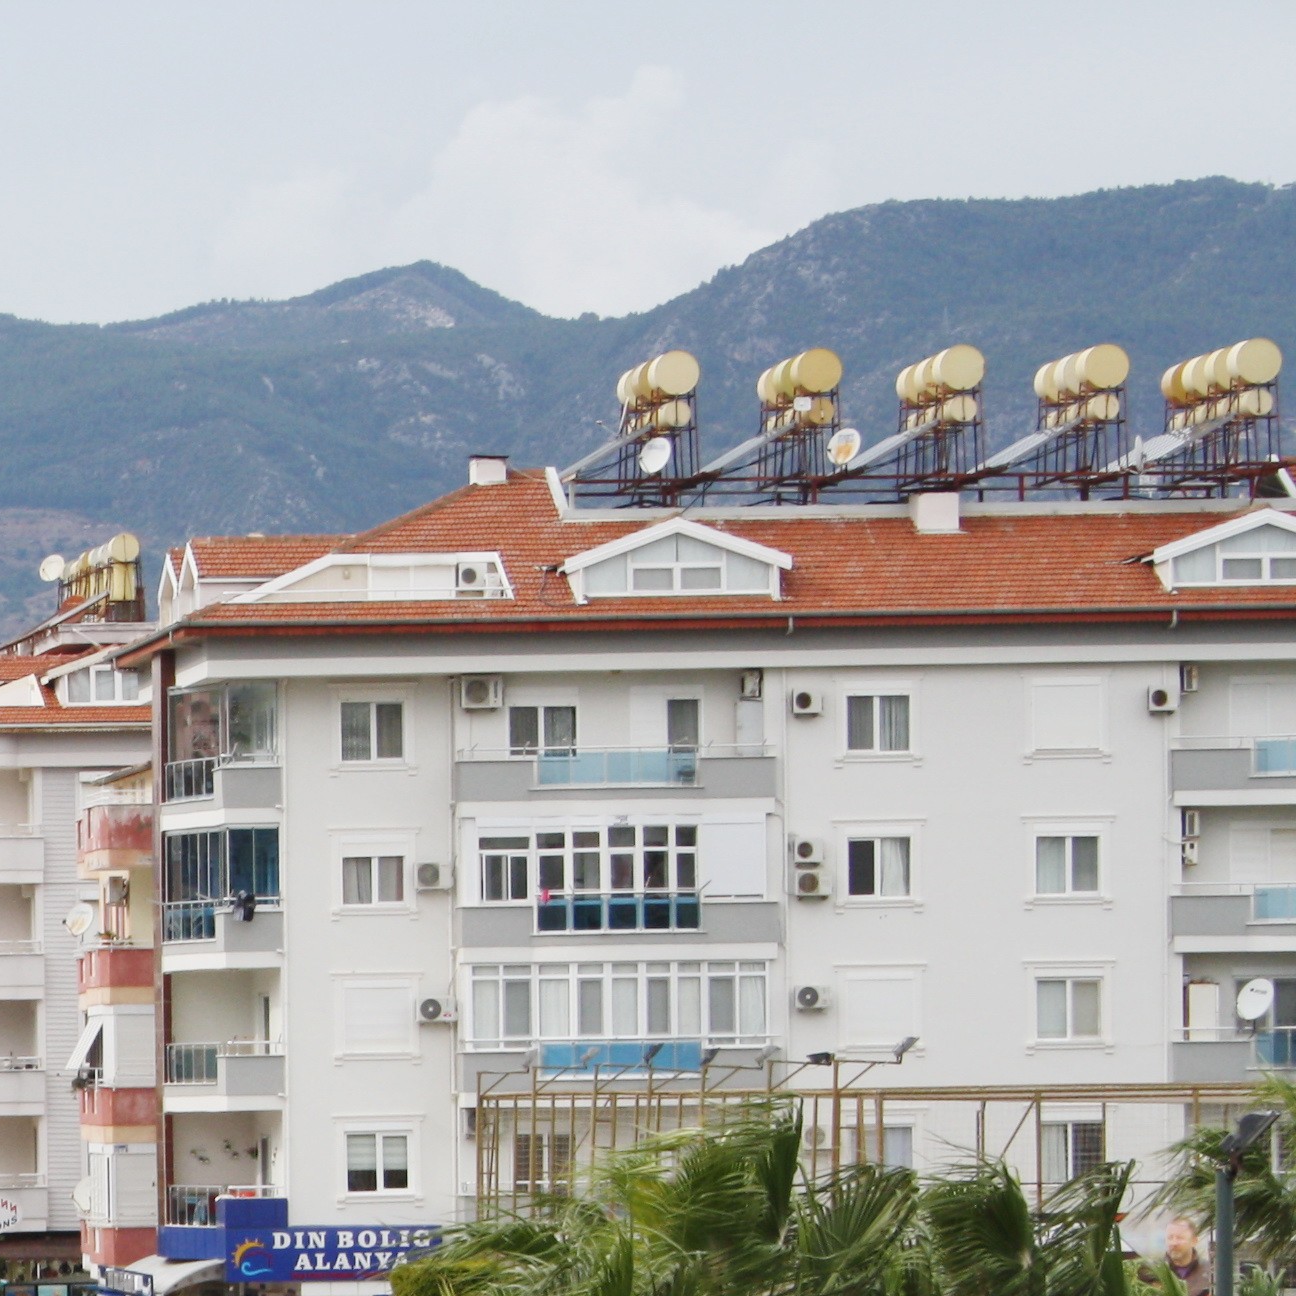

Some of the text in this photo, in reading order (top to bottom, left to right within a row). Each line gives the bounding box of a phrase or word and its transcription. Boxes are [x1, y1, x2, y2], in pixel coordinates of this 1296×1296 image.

[272, 1229, 431, 1249] DIN BOLIG
[294, 1252, 408, 1270] ALANYA
